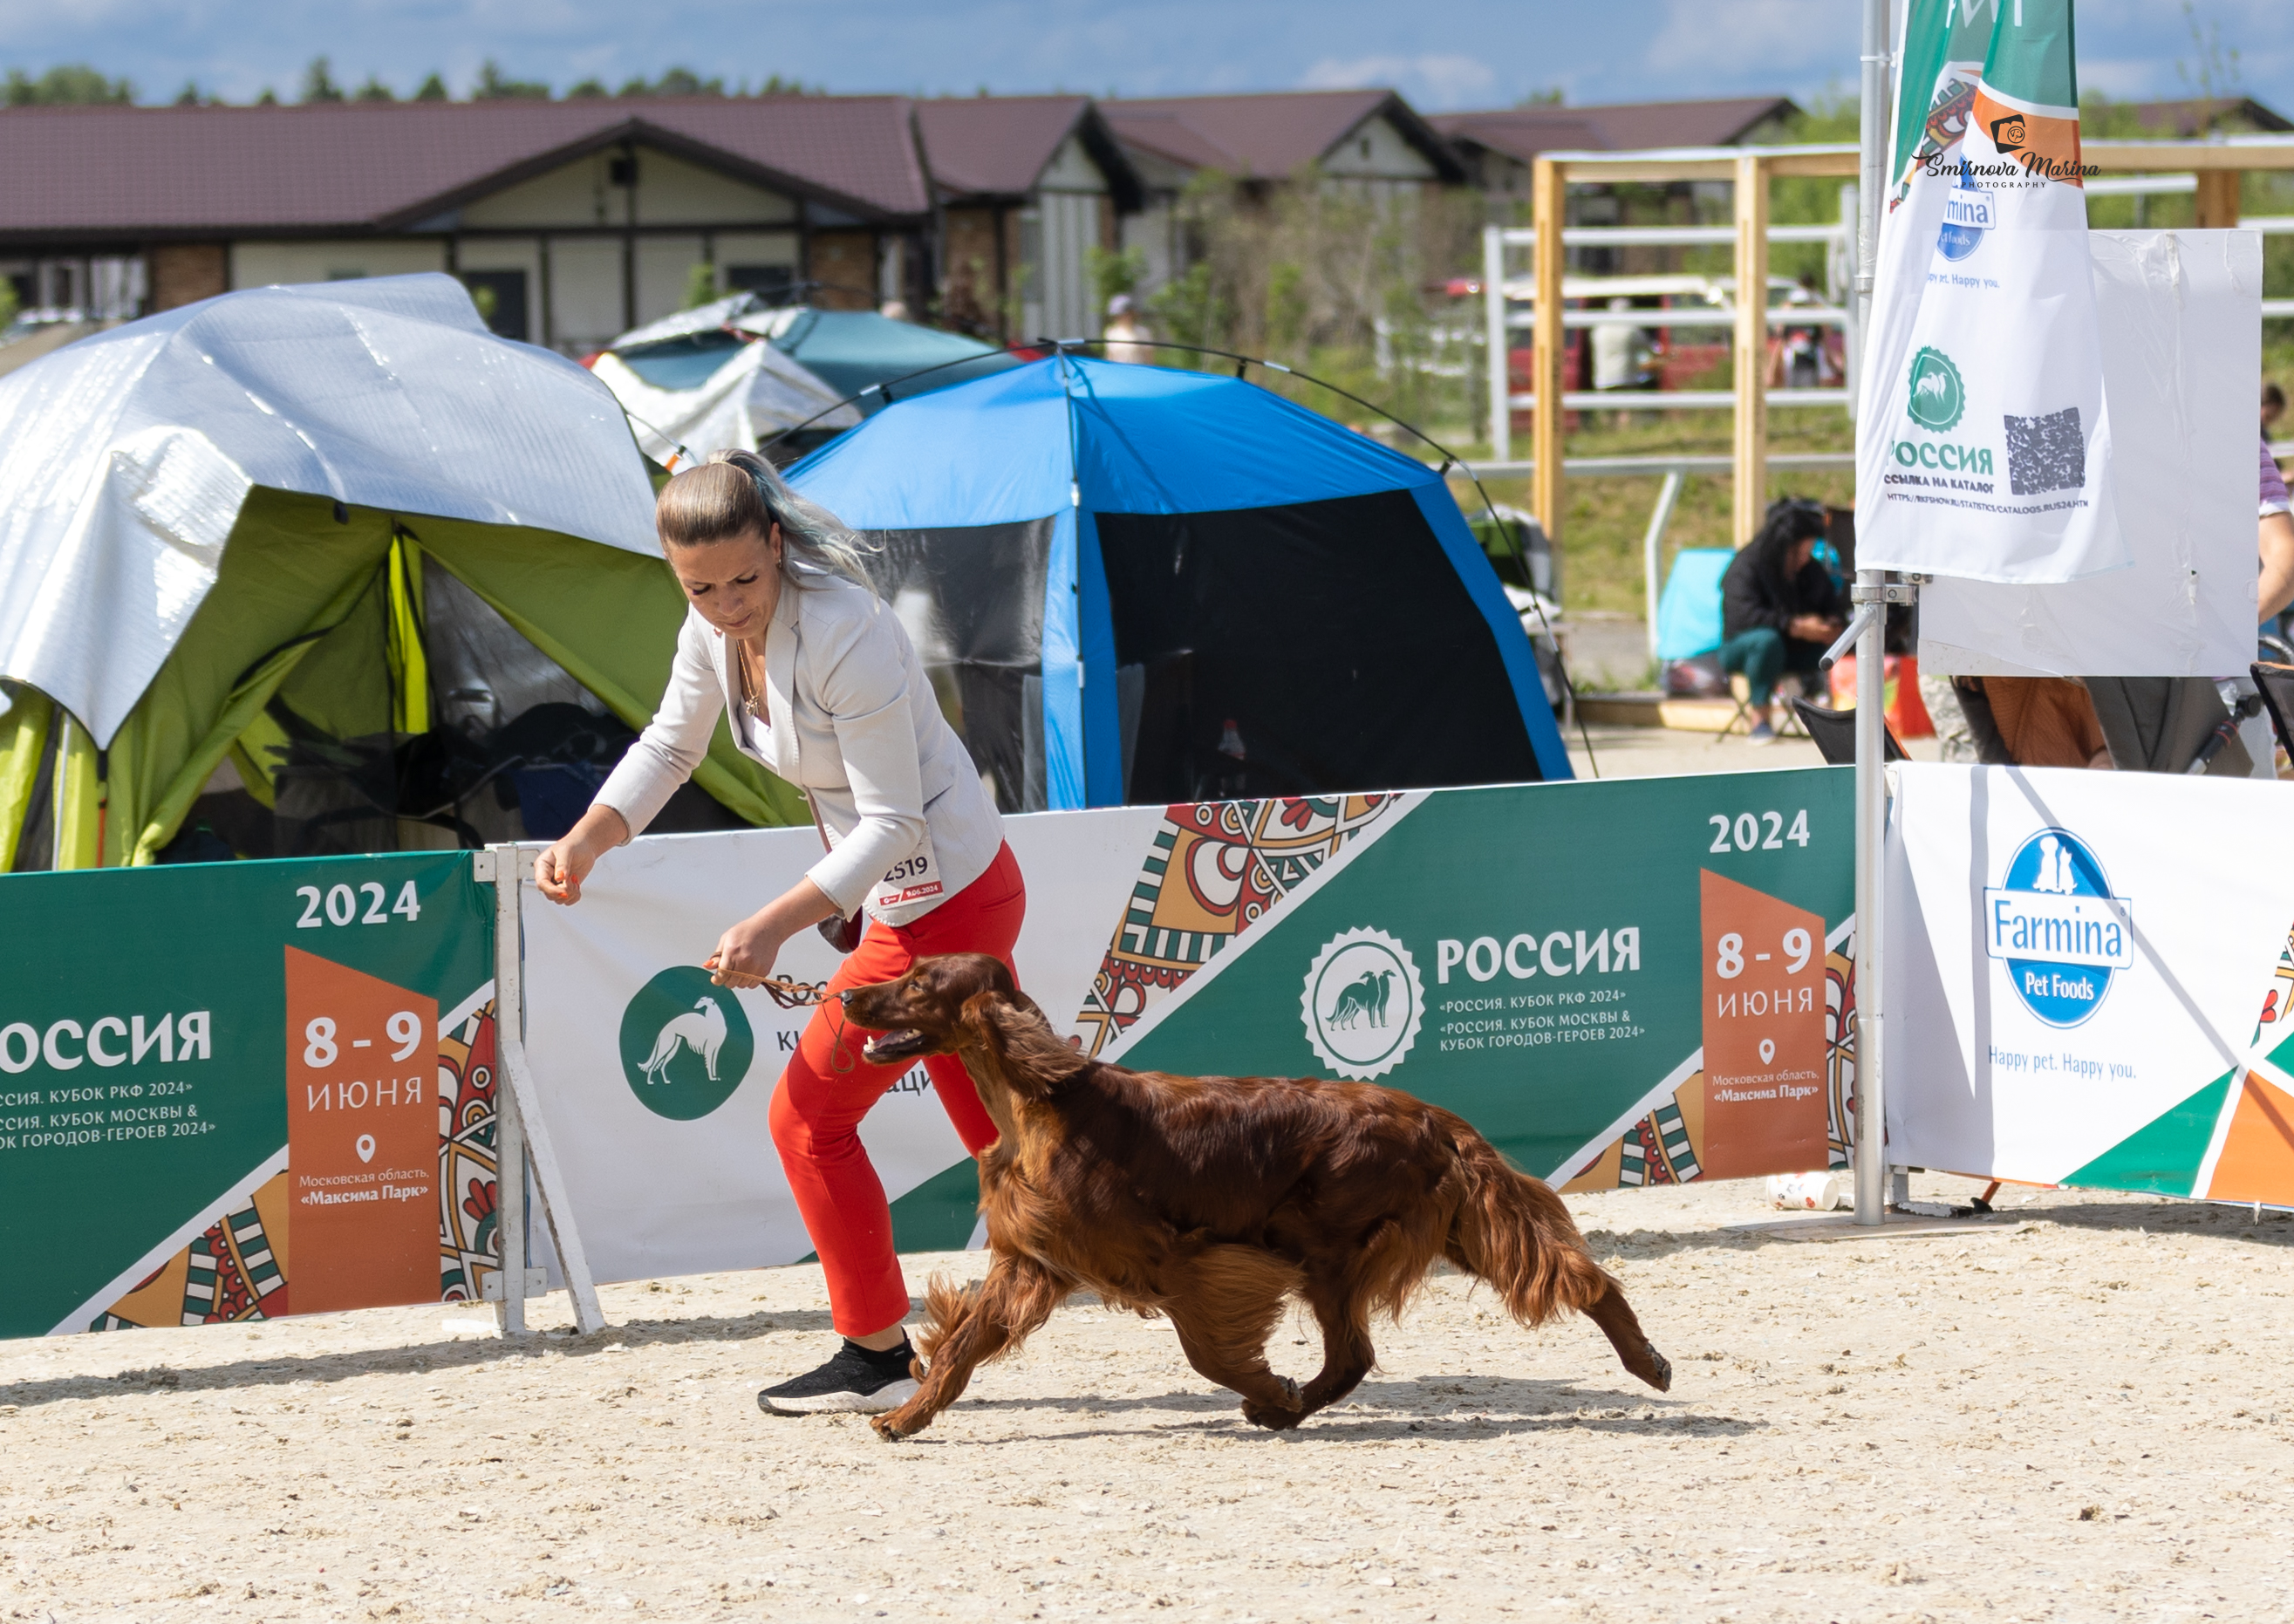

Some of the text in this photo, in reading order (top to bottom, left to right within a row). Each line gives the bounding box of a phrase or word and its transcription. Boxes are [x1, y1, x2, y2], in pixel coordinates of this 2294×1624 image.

[1947, 194, 1989, 224] mina
[1951, 274, 1981, 289] Happy
[1983, 278, 2001, 290] you.
[1883, 474, 1995, 495] ССЫЛКА НА КАТАЛОГ
[1707, 809, 1812, 854] 2024
[883, 856, 928, 883] 2519
[295, 880, 422, 930] 2024
[1992, 898, 2123, 958] Farmina
[1435, 926, 1642, 986] РОССИЯ
[1715, 932, 1746, 979] 8
[1781, 927, 1813, 975] 9
[2024, 972, 2095, 1002] Pet Foods
[1439, 989, 1627, 1013] «РОССИЯ. КУБОК РКФ 2024»
[1716, 986, 1814, 1020] ИЮНЯ
[1439, 1010, 1631, 1035] «РОССИЯ. КУБОК МОСКВЫ &
[0, 1010, 212, 1074] ОССИЯ
[303, 1017, 339, 1068] 8
[386, 1011, 423, 1063] 9
[1439, 1026, 1646, 1052] КУБОК ГОРОДОВ-ГЕРОЕВ 2024»
[1988, 1044, 2137, 1082] Happy pet. Happy you.
[1712, 1068, 1820, 1087] Московская область,
[50, 1087, 105, 1103] КУБОК
[109, 1084, 144, 1099] РКФ
[148, 1081, 194, 1096] 2024»
[305, 1076, 424, 1114] ИЮНЯ
[1713, 1084, 1819, 1102] «Максима Парк»
[50, 1111, 105, 1128] КУБОК
[110, 1105, 182, 1122] МОСКВЫ
[187, 1103, 198, 1117] &
[23, 1125, 167, 1147] ГОРОДОВ-ГЕРОЕВ
[171, 1121, 216, 1136] 2024»
[298, 1167, 430, 1188] Московская область,
[300, 1184, 429, 1206] «Максима Парк»
